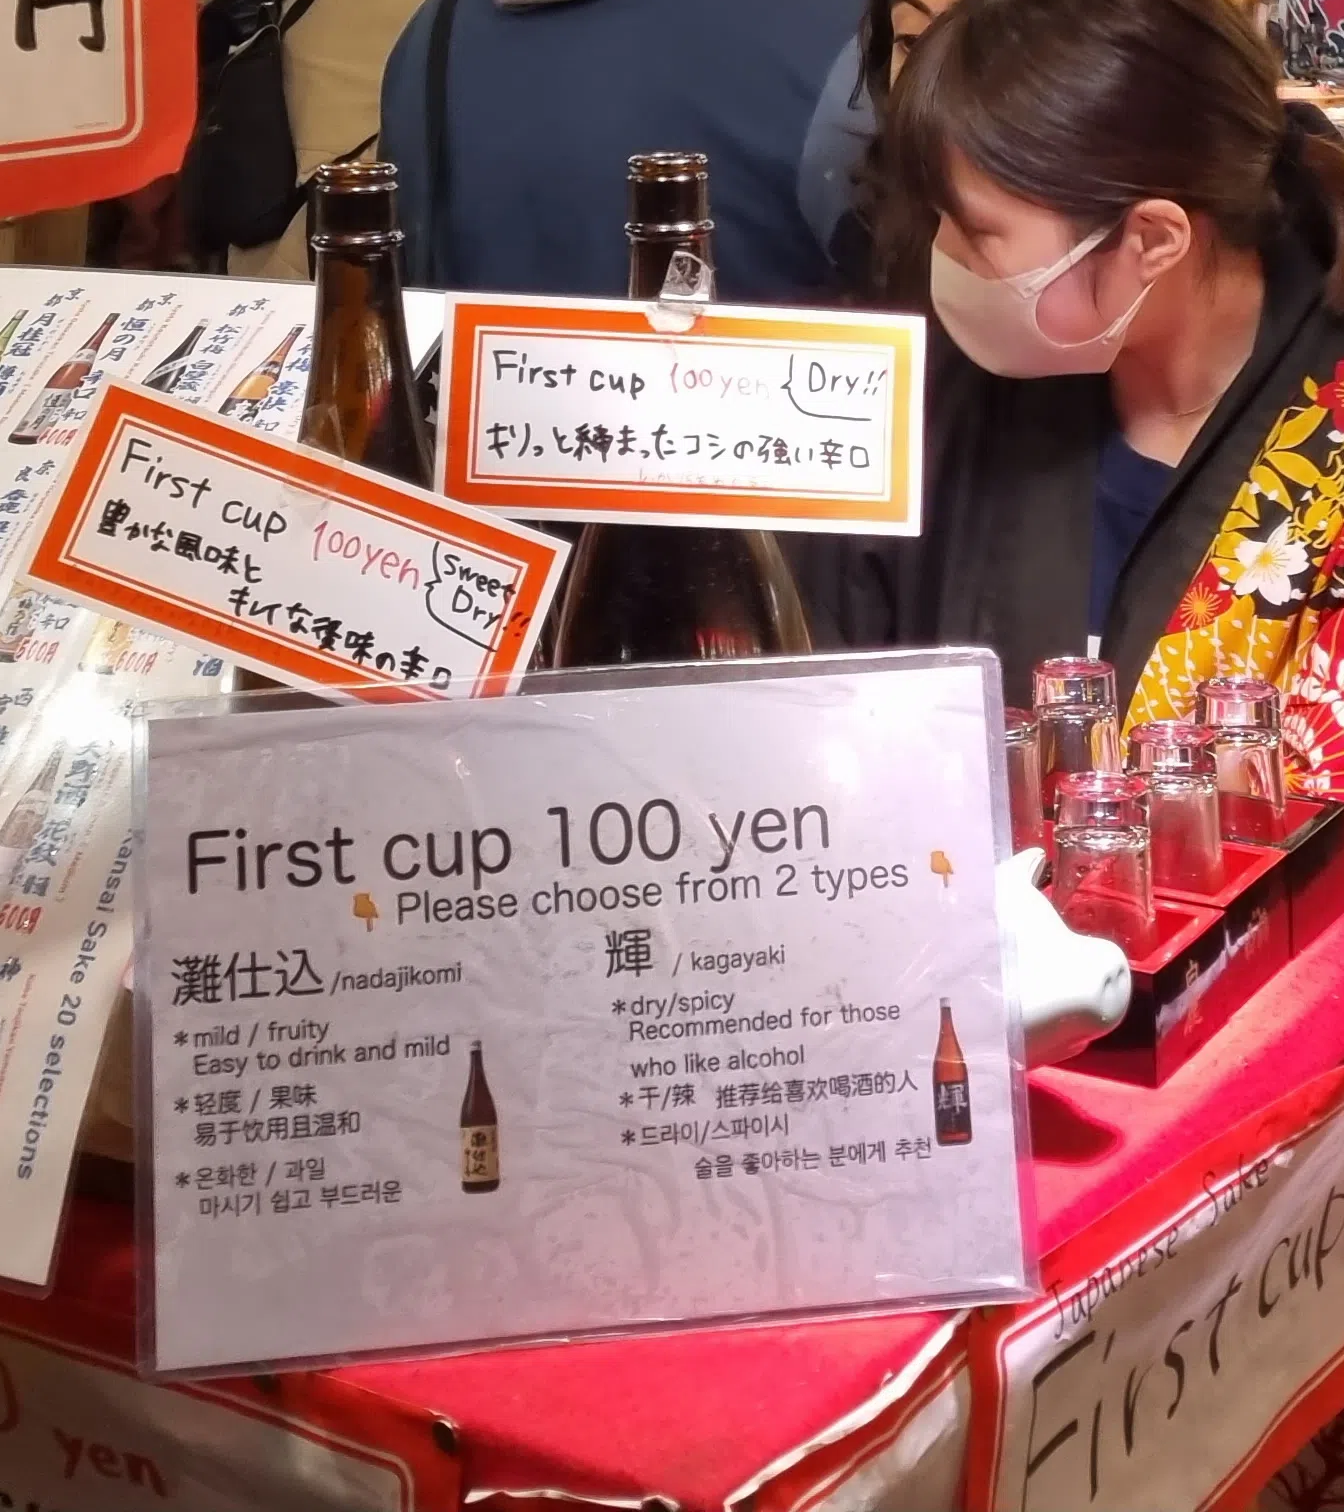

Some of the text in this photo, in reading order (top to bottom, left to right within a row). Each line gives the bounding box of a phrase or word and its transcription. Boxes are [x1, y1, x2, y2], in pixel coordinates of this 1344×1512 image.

[4, 312, 56, 357] 月桂冠
[99, 317, 149, 362] 恒の月
[200, 324, 241, 355] 松竹梅
[493, 350, 577, 388] First
[590, 374, 646, 400] cup
[120, 438, 213, 509] First
[221, 499, 288, 544] cup
[96, 498, 263, 584] 豊かな風味と
[444, 554, 516, 599] Sweet
[188, 798, 830, 894] First cup 100 yen
[396, 862, 909, 925] Please choose from 2 types
[69, 918, 106, 985] Sake
[605, 928, 786, 977] 輝 kagayaki
[171, 949, 325, 1006] 灘仕込
[56, 994, 82, 1026] 20
[267, 1019, 330, 1045] fruity
[628, 1002, 900, 1041] Recommended for those
[193, 1035, 450, 1078] Easy to drink and mild
[630, 1044, 806, 1079] who like alcohol
[16, 1036, 65, 1181] selections
[269, 1085, 317, 1109] 果味
[195, 1157, 326, 1190] 온화한 과일
[694, 1137, 932, 1180] 술을 좋아하는 분에게 추천
[199, 1180, 402, 1220] 마시기 쉽고 부드러운
[1051, 1155, 1272, 1339] Japanese Sake
[1019, 1272, 1246, 1512] First
[52, 1425, 167, 1499] yen
